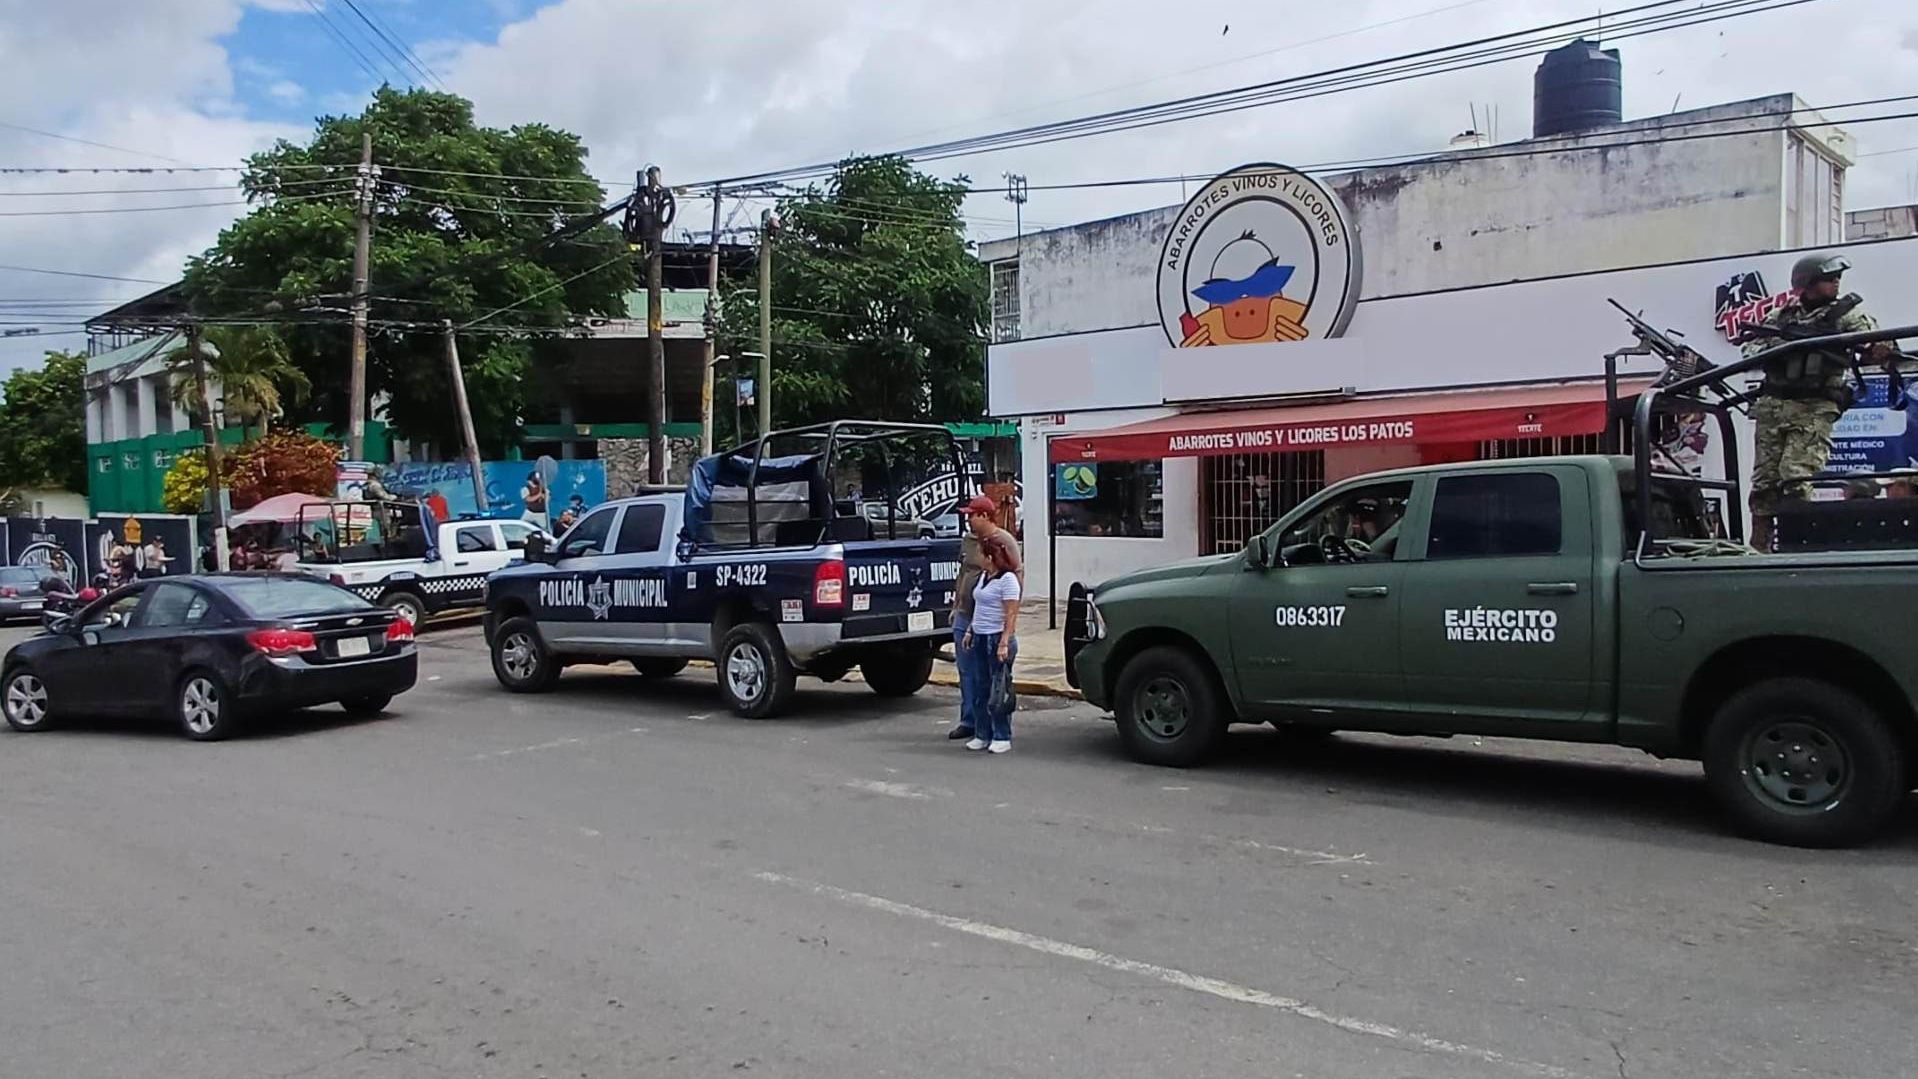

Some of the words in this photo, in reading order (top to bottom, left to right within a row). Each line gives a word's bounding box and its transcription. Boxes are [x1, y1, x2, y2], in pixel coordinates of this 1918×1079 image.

[1167, 185, 1229, 270] ABARROTES
[1232, 175, 1278, 192] VINOS
[1281, 178, 1293, 192] Y
[1292, 184, 1338, 247] LICORES
[1168, 432, 1233, 451] ABARROTES
[1236, 430, 1272, 447] VINOS
[1274, 429, 1284, 445] Y
[1287, 426, 1338, 444] LICORES
[1341, 424, 1366, 441] LOS
[1369, 421, 1413, 440] PATOS
[1829, 452, 1868, 461] CULTURA
[716, 564, 767, 587] SP-4322
[848, 560, 901, 587] POLICÍA
[540, 573, 585, 607] POLICÍA
[614, 579, 668, 607] MUNICIPAL
[1276, 606, 1346, 627] 0863317
[1444, 605, 1558, 628] EJÉRCITO
[1446, 627, 1556, 642] MEXICANO
